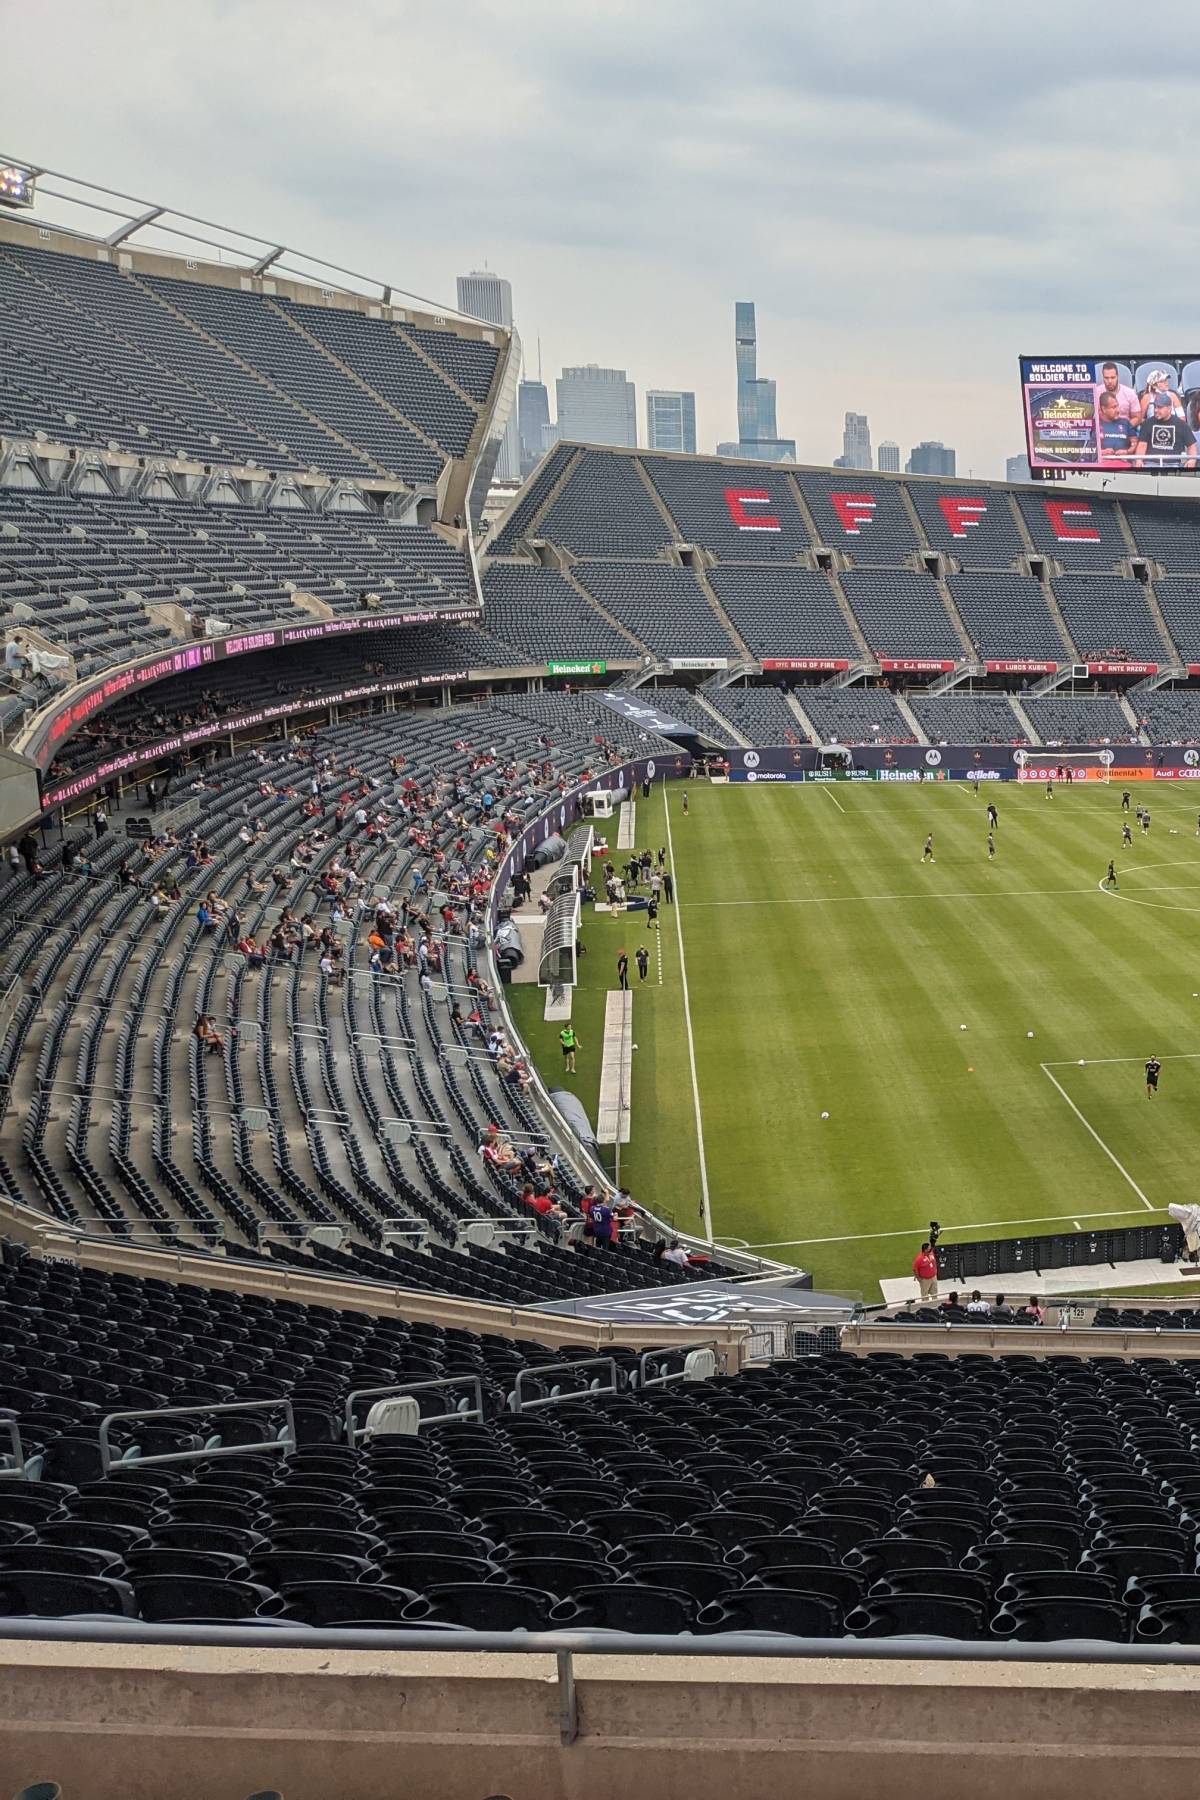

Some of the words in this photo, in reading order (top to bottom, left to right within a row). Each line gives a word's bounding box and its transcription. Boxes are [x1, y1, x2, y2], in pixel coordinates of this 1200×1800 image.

[1031, 364, 1073, 373] WELCOME
[1077, 364, 1088, 372] TO
[1029, 374, 1064, 382] SOLDIER
[1067, 373, 1092, 382] FIELD
[1043, 410, 1083, 419] Heineken
[445, 611, 480, 620] BLACKSTONE
[552, 664, 590, 673] Heineken
[880, 770, 934, 780] Heineken
[593, 1211, 602, 1222] 10
[1073, 1308, 1084, 1316] 125
